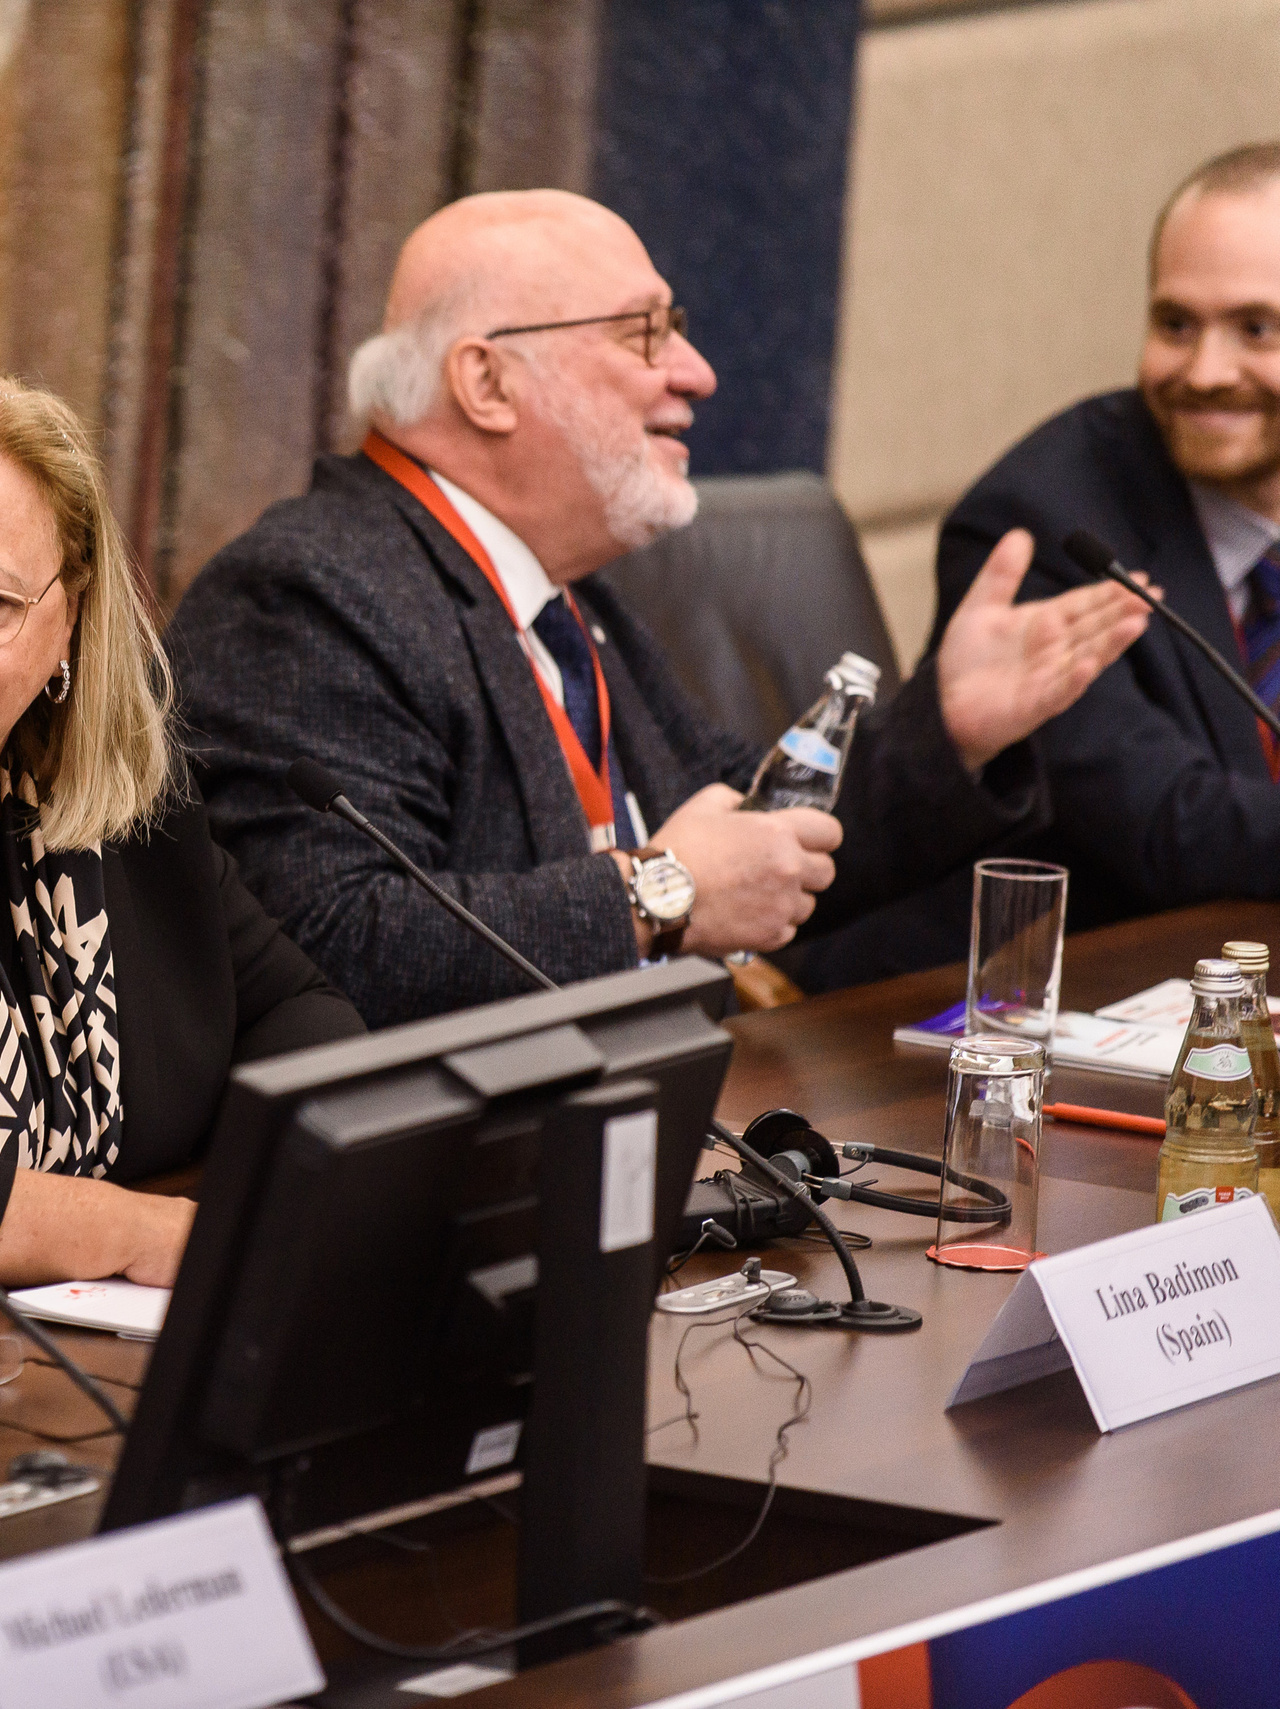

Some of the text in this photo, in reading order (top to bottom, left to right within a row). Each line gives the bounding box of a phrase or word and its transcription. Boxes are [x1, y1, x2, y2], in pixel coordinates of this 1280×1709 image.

[1095, 1256, 1240, 1322] Lina Badimon
[1156, 1308, 1233, 1366] (Spain)
